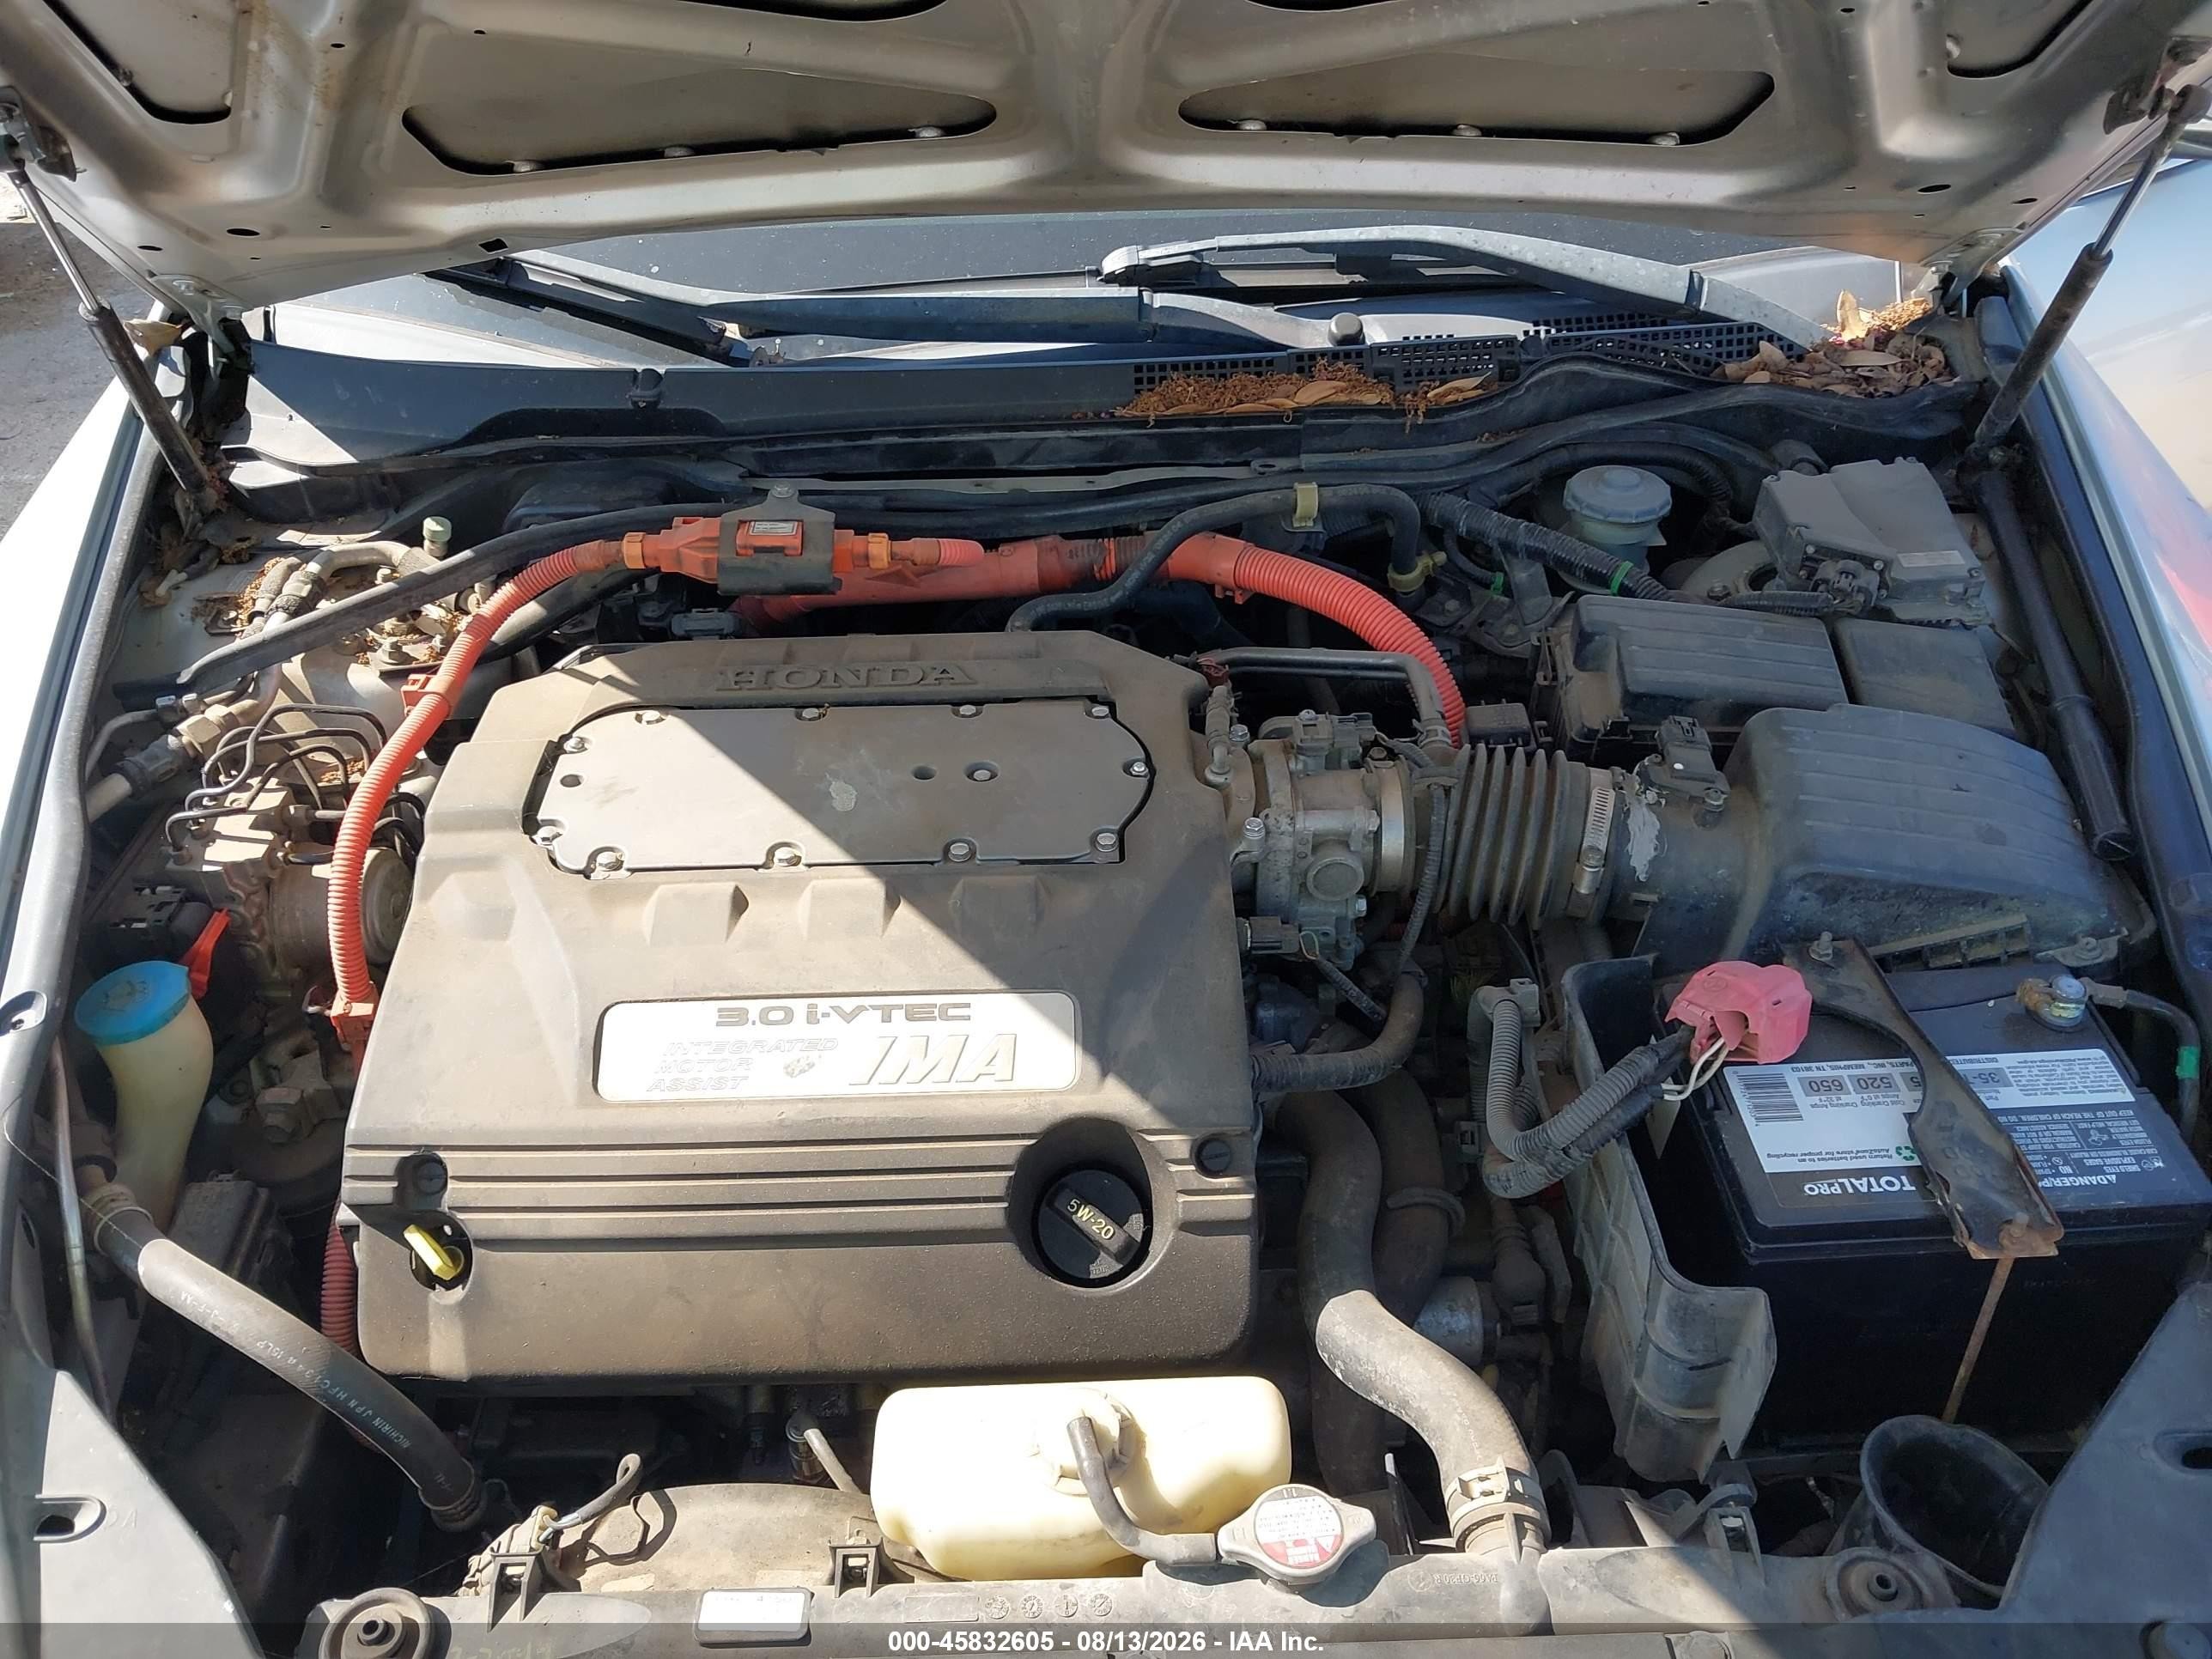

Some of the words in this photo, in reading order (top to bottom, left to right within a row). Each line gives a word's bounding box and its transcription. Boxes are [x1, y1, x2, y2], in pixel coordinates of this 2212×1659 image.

[715, 664, 976, 690] HONDA
[716, 1006, 793, 1027] 3.0
[806, 1002, 971, 1024] i-VTEC
[663, 1038, 838, 1055] INTEGRATED
[654, 1057, 753, 1074] MOTOR
[848, 1033, 1018, 1085] IMA
[647, 1076, 748, 1091] ASSIST
[1808, 1079, 1843, 1092] 650
[1856, 1077, 1893, 1090] 520
[1066, 1199, 1115, 1240] 5W-20
[348, 1399, 373, 1419] JPN
[373, 1417, 412, 1450] NICHIRIN
